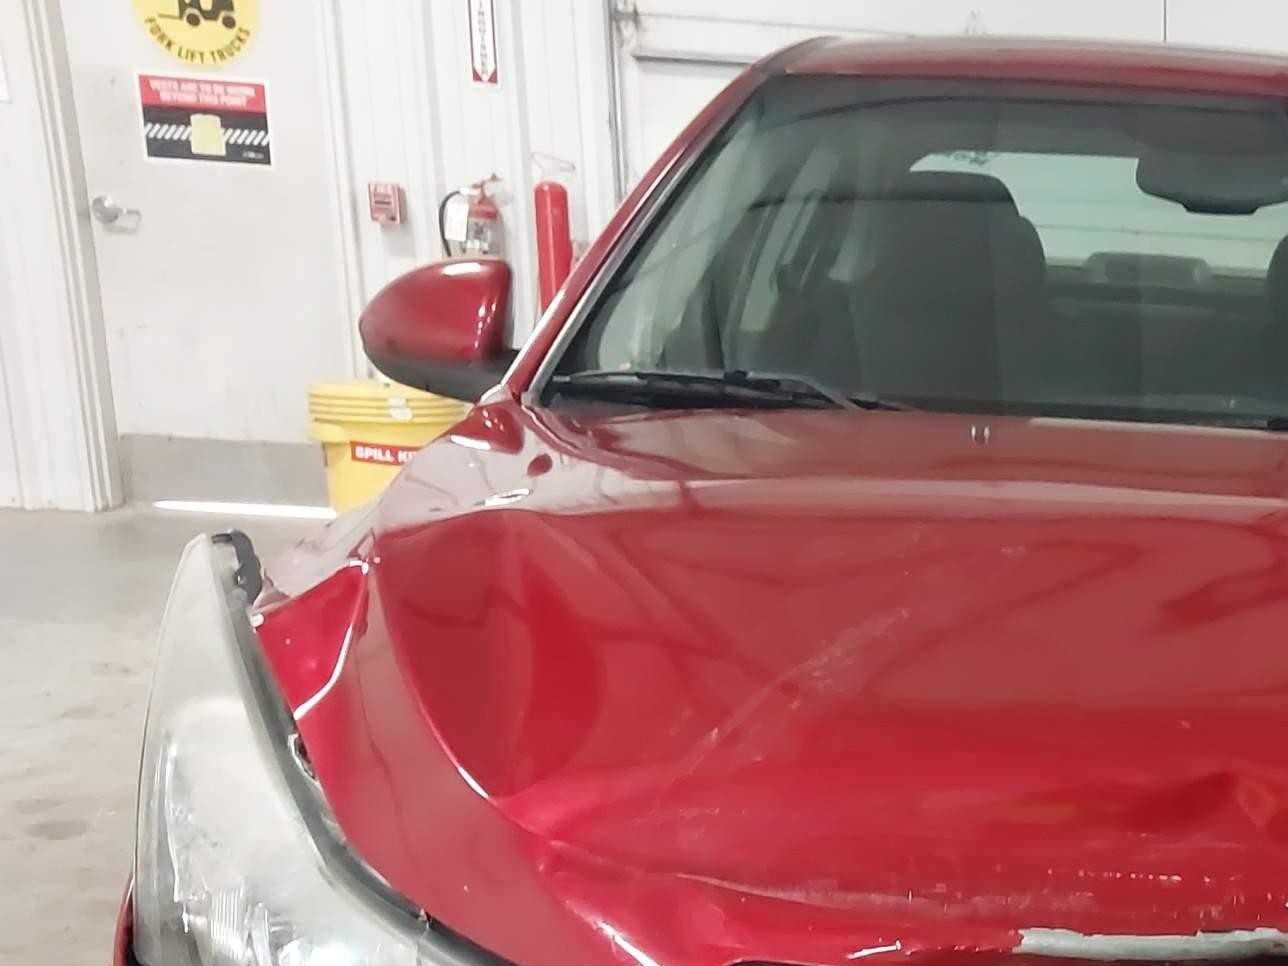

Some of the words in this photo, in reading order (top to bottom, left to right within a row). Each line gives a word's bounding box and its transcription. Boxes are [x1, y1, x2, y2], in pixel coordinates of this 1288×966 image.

[144, 17, 175, 51] FORK
[177, 46, 205, 64] LIFT
[210, 27, 251, 63] TRUCKS
[355, 445, 395, 463] SPILL
